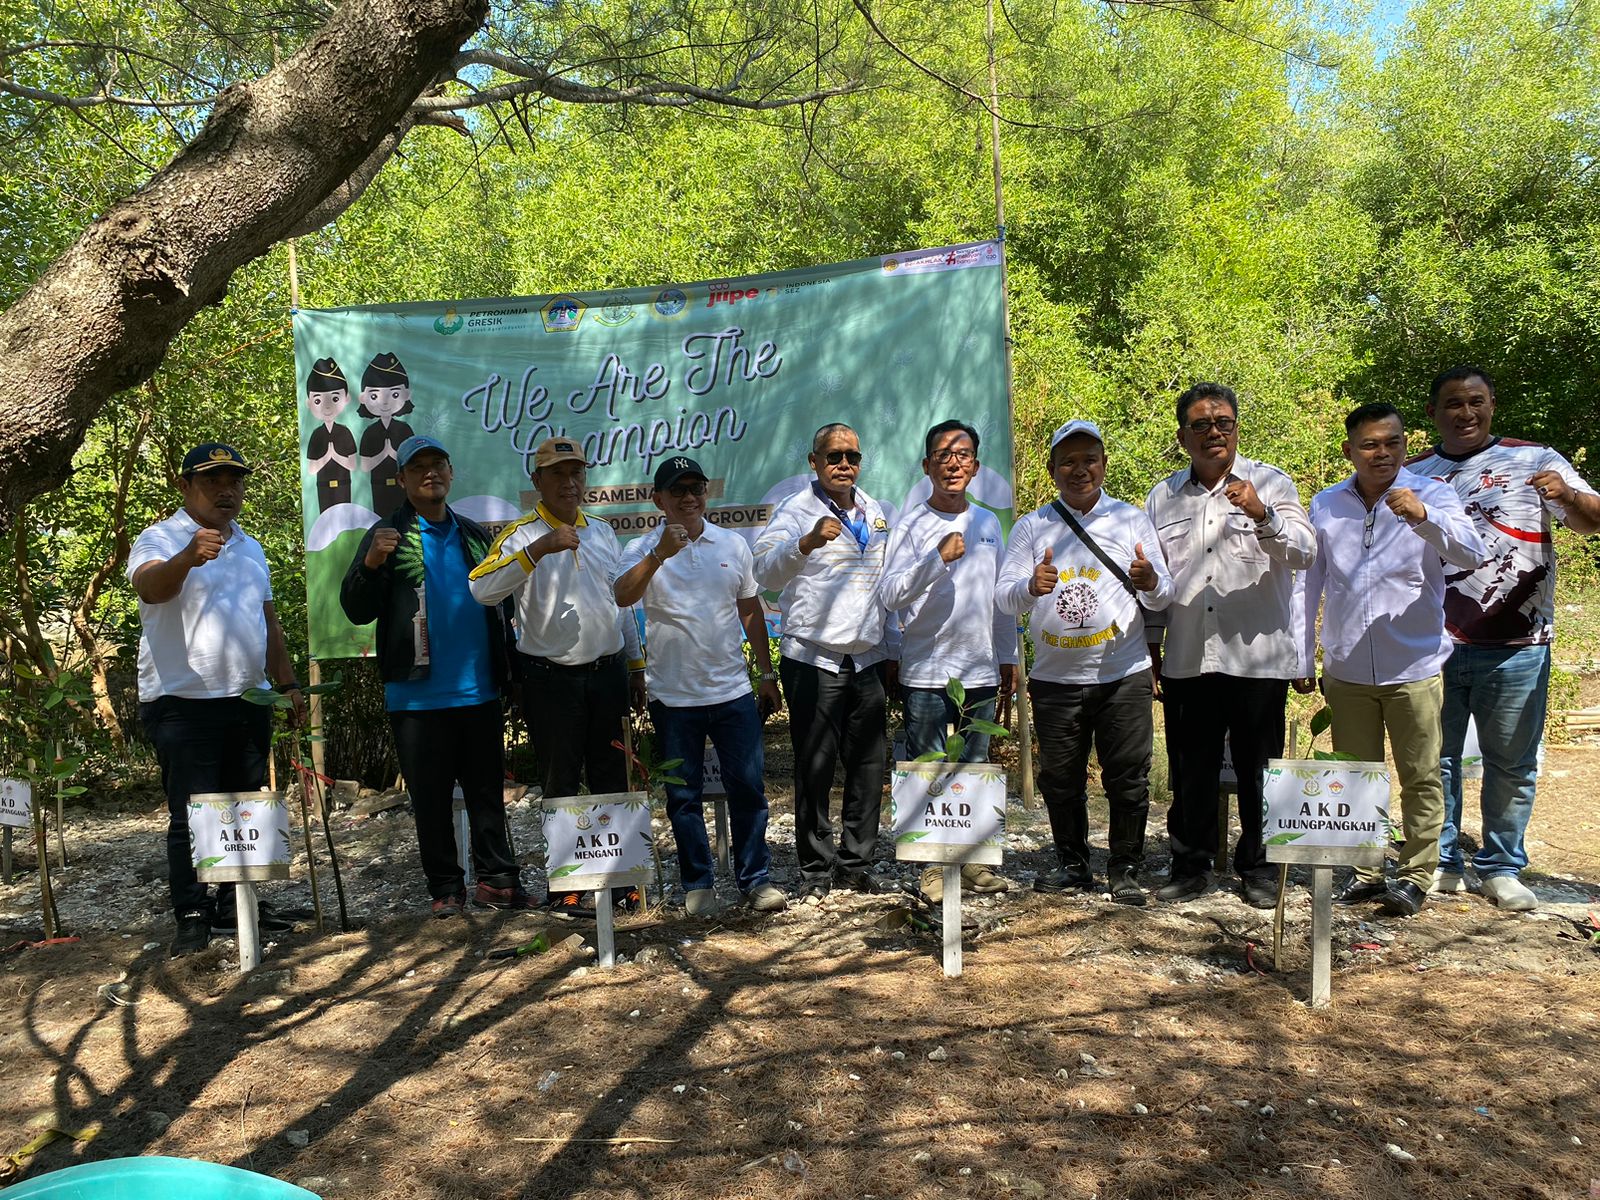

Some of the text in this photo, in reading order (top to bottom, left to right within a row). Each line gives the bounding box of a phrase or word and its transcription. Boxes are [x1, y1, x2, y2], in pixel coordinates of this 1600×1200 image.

[785, 278, 831, 289] INDONESIA
[469, 307, 528, 318] PETROKIMIA
[467, 317, 503, 328] GRESIK
[461, 326, 783, 434] We Are The
[510, 405, 748, 480] Campion
[703, 508, 767, 524] GROVE
[1058, 565, 1102, 584] WE ARE
[1041, 629, 1059, 647] THE
[925, 819, 971, 828] PANCENG
[1278, 818, 1376, 832] UJUNGPANGKAH
[224, 843, 256, 852] GRESIK
[574, 848, 623, 860] MENGANTI
